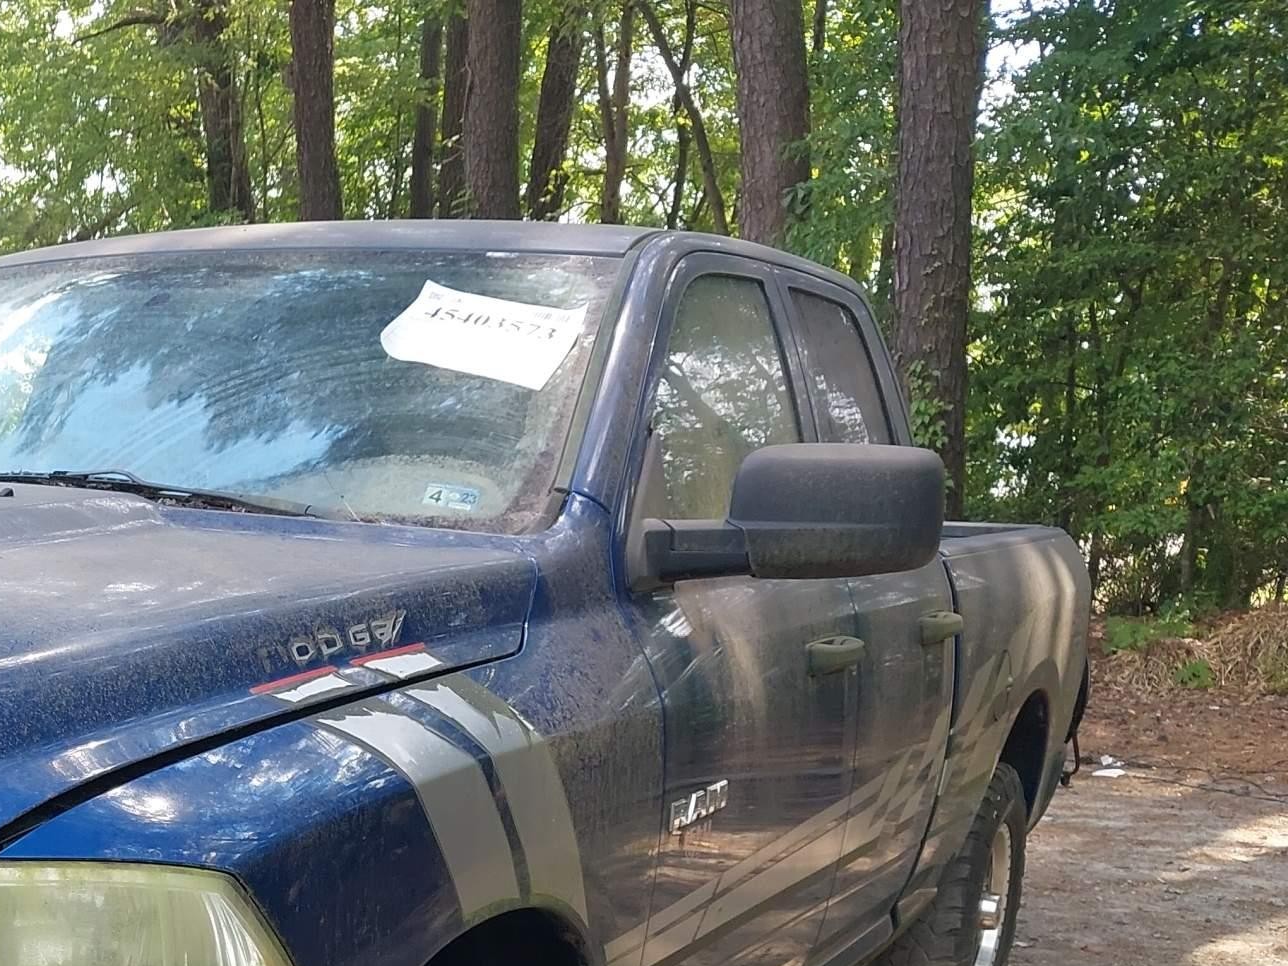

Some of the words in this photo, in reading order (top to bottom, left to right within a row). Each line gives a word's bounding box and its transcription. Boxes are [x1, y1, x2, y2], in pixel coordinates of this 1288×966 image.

[424, 306, 557, 341] 45403573
[428, 489, 443, 504] 4
[459, 492, 478, 505] 23
[256, 609, 407, 674] ODGE
[669, 779, 729, 835] RAM
